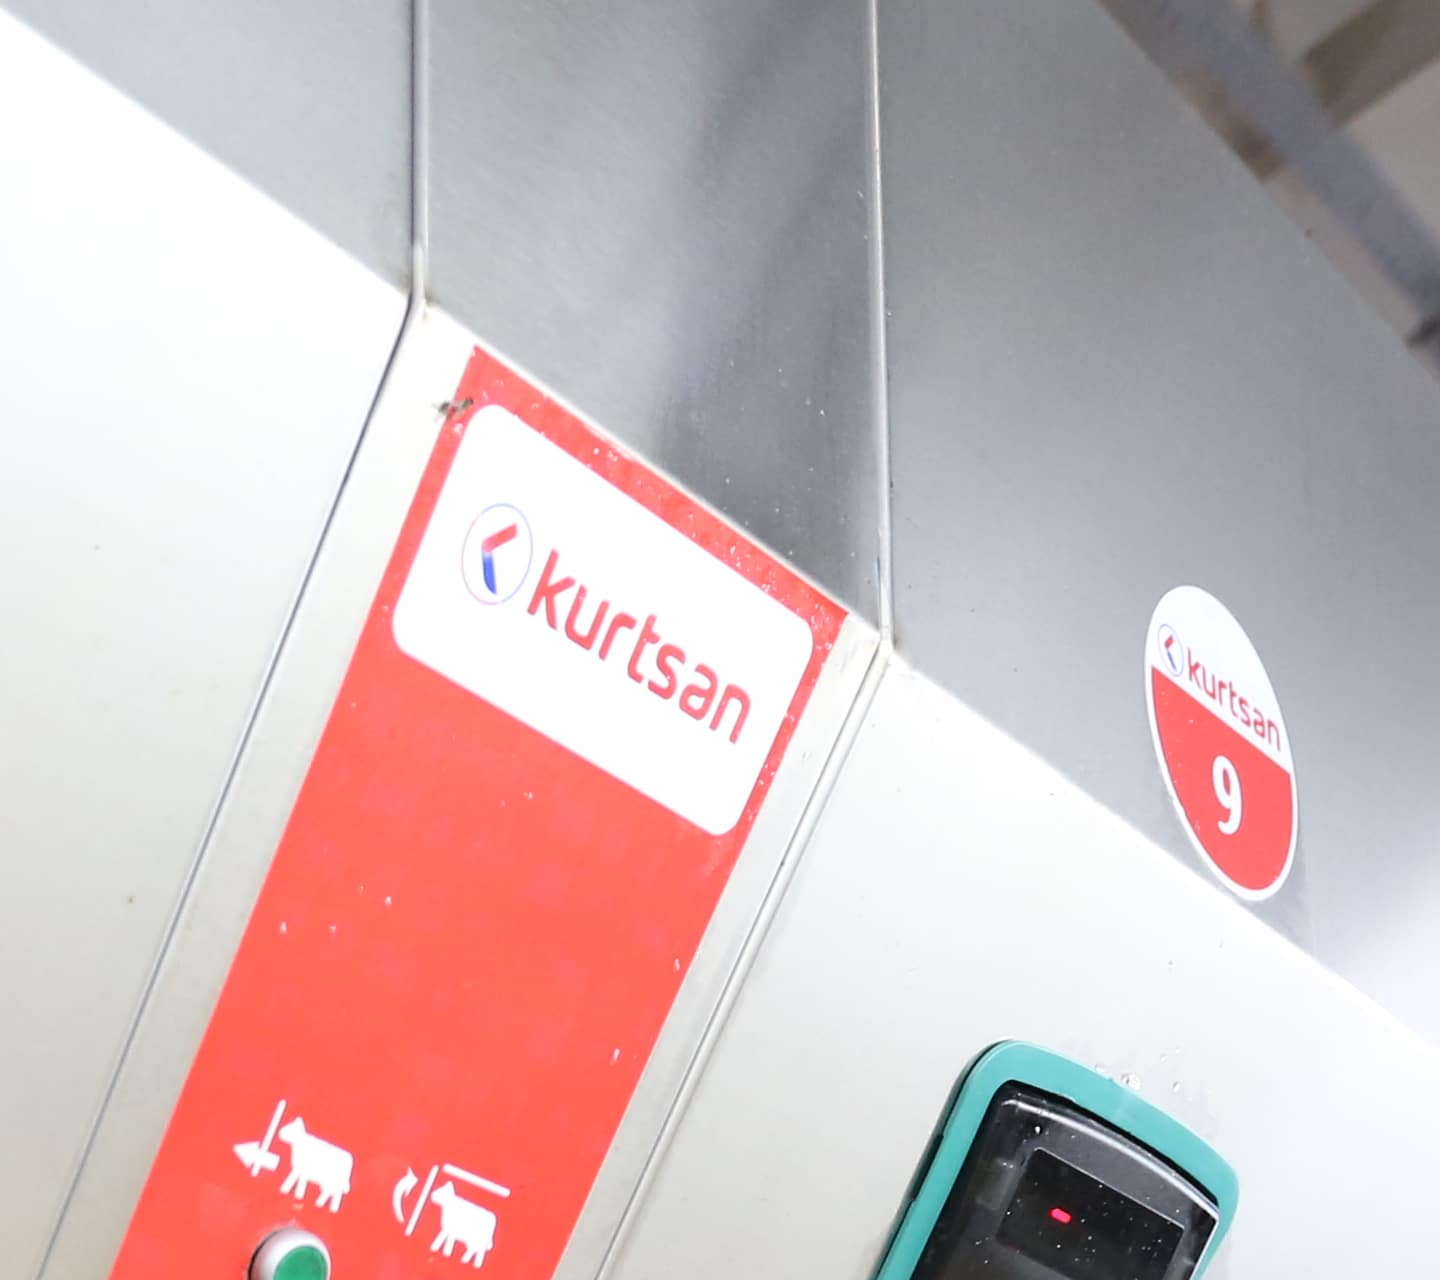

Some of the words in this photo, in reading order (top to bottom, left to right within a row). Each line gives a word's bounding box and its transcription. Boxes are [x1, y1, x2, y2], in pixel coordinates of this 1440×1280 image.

[526, 547, 751, 745] kurtsan
[1187, 646, 1282, 752] kurtsan
[1212, 755, 1244, 835] 9
